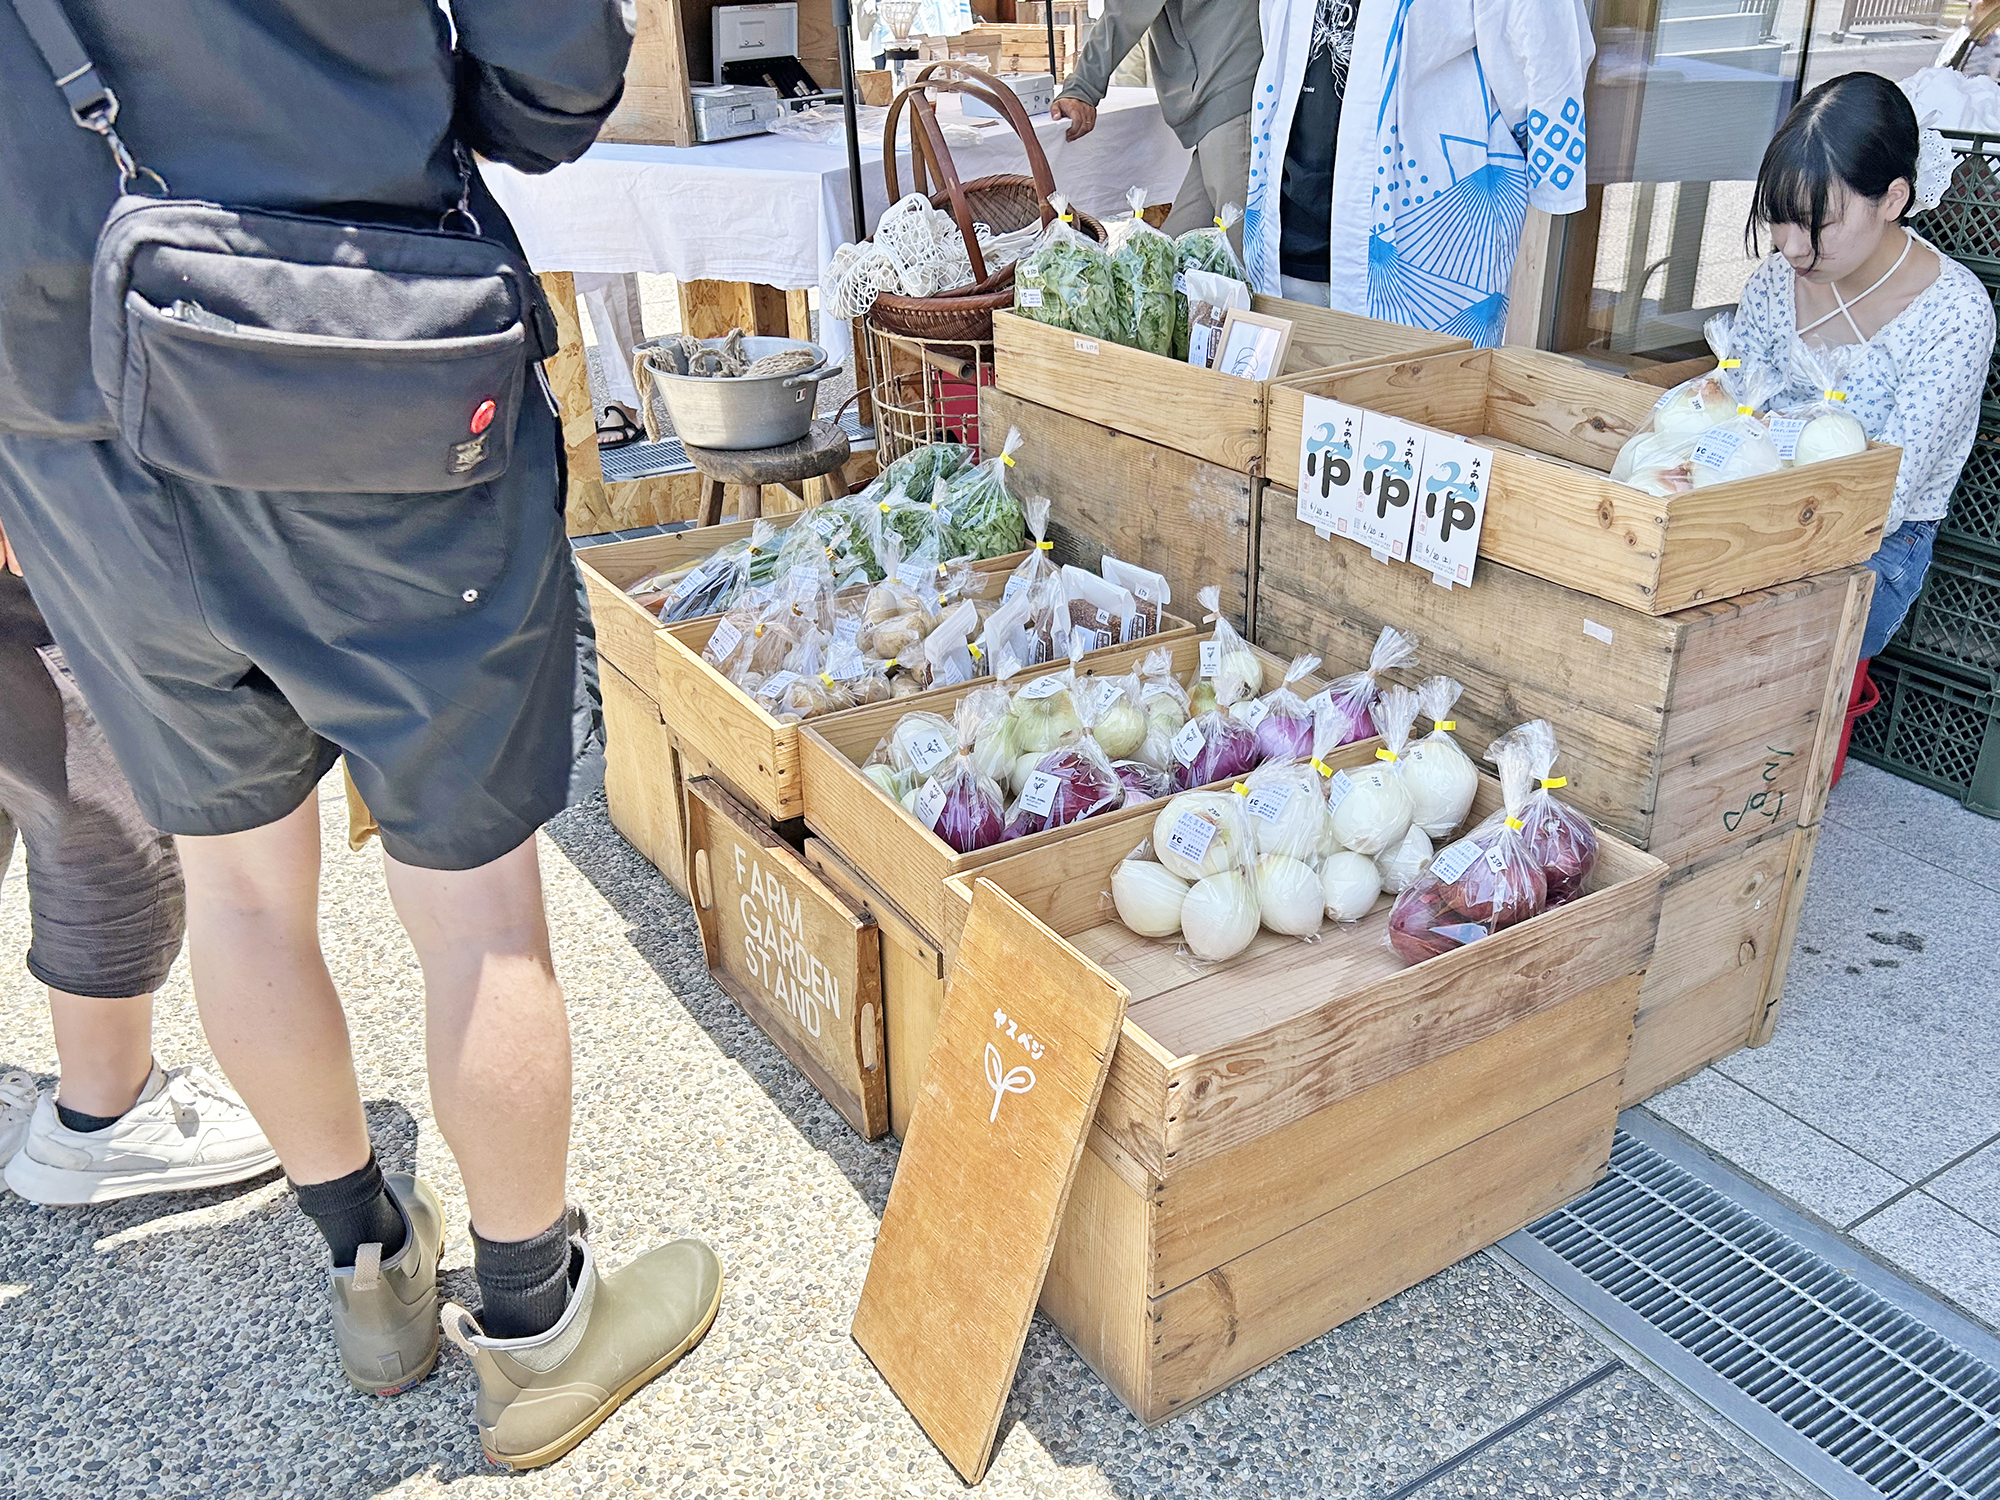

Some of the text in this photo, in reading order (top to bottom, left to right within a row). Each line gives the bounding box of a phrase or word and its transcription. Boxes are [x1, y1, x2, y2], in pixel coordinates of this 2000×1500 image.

[733, 842, 804, 940] FARM
[1489, 853, 1504, 869] 250
[739, 893, 841, 1020] GARDEN
[744, 934, 822, 1039] STAND
[991, 1007, 1047, 1061] ヤスベジ
